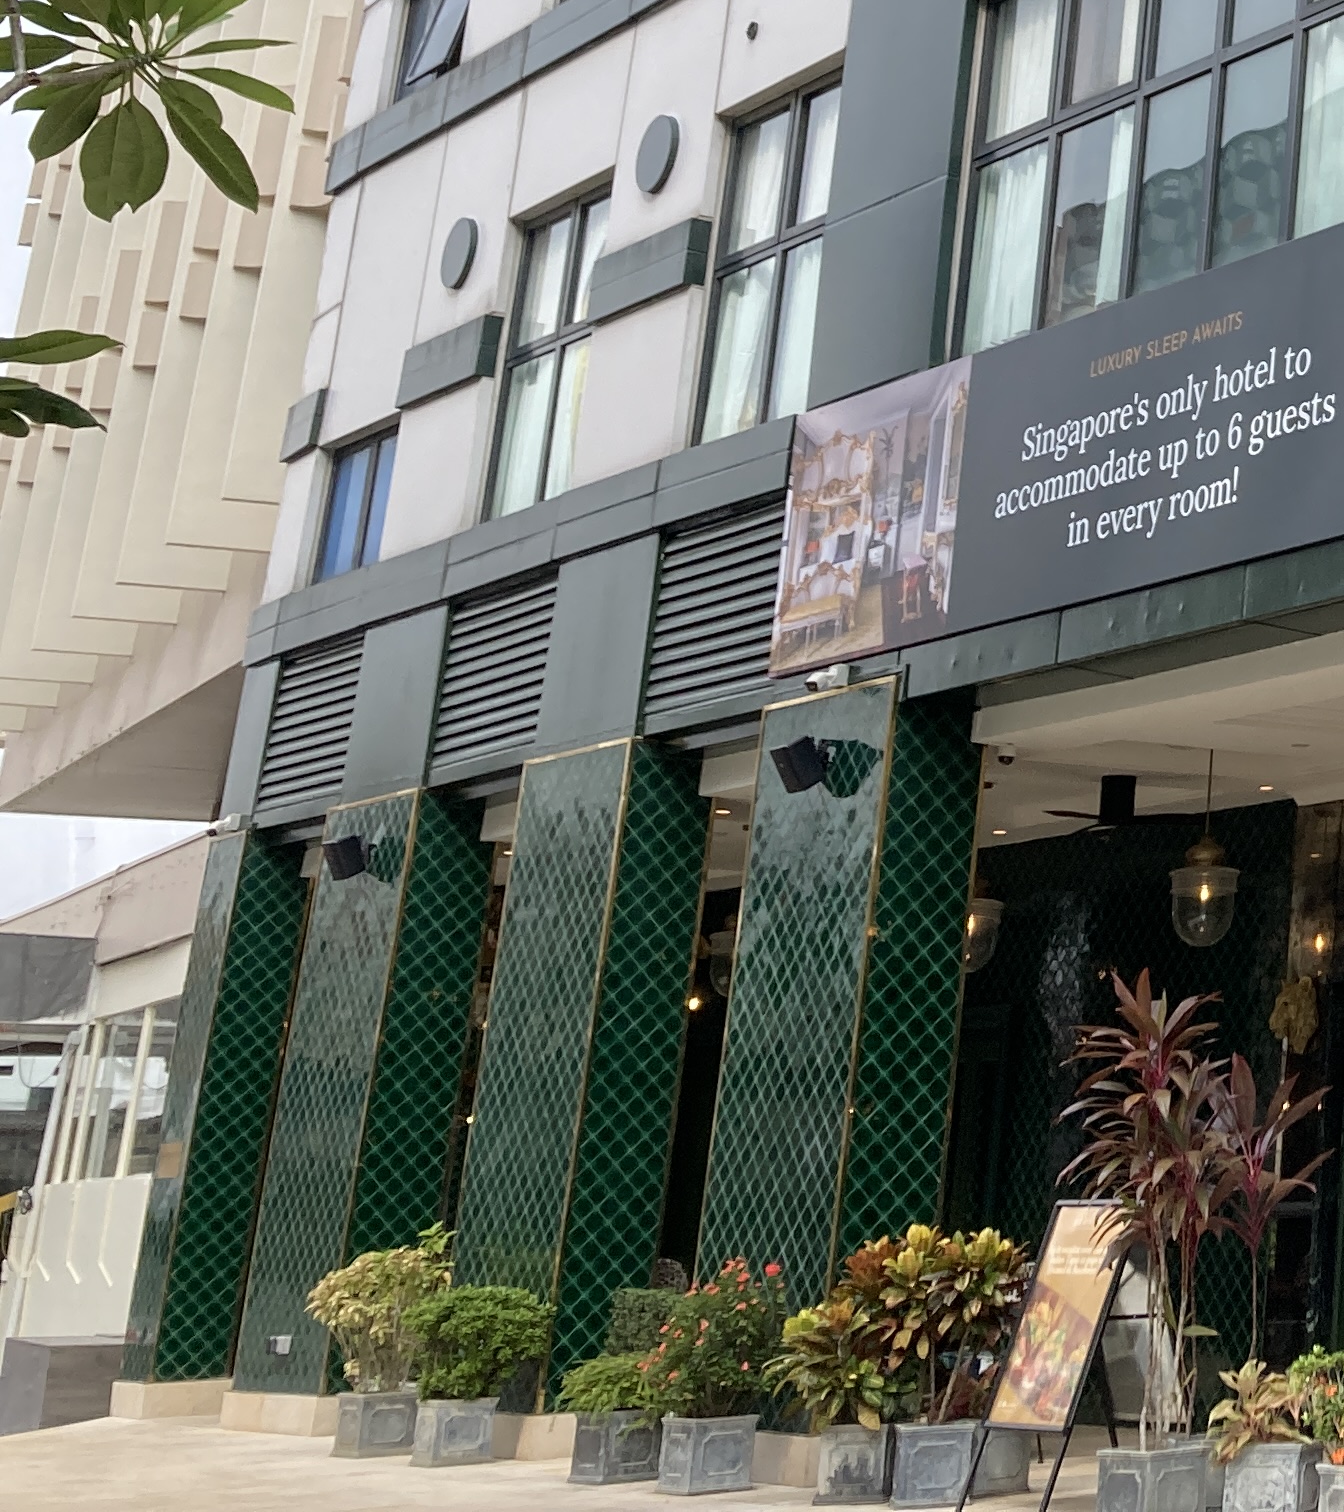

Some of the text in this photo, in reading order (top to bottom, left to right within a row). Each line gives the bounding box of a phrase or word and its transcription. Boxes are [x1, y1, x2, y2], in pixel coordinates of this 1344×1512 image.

[1088, 310, 1243, 378] LUXURY SLEEP AWAITS
[1021, 346, 1312, 463] Singapore's only hotel to
[994, 392, 1337, 519] accommodate up to 6 guests
[1066, 466, 1240, 548] in every room!
